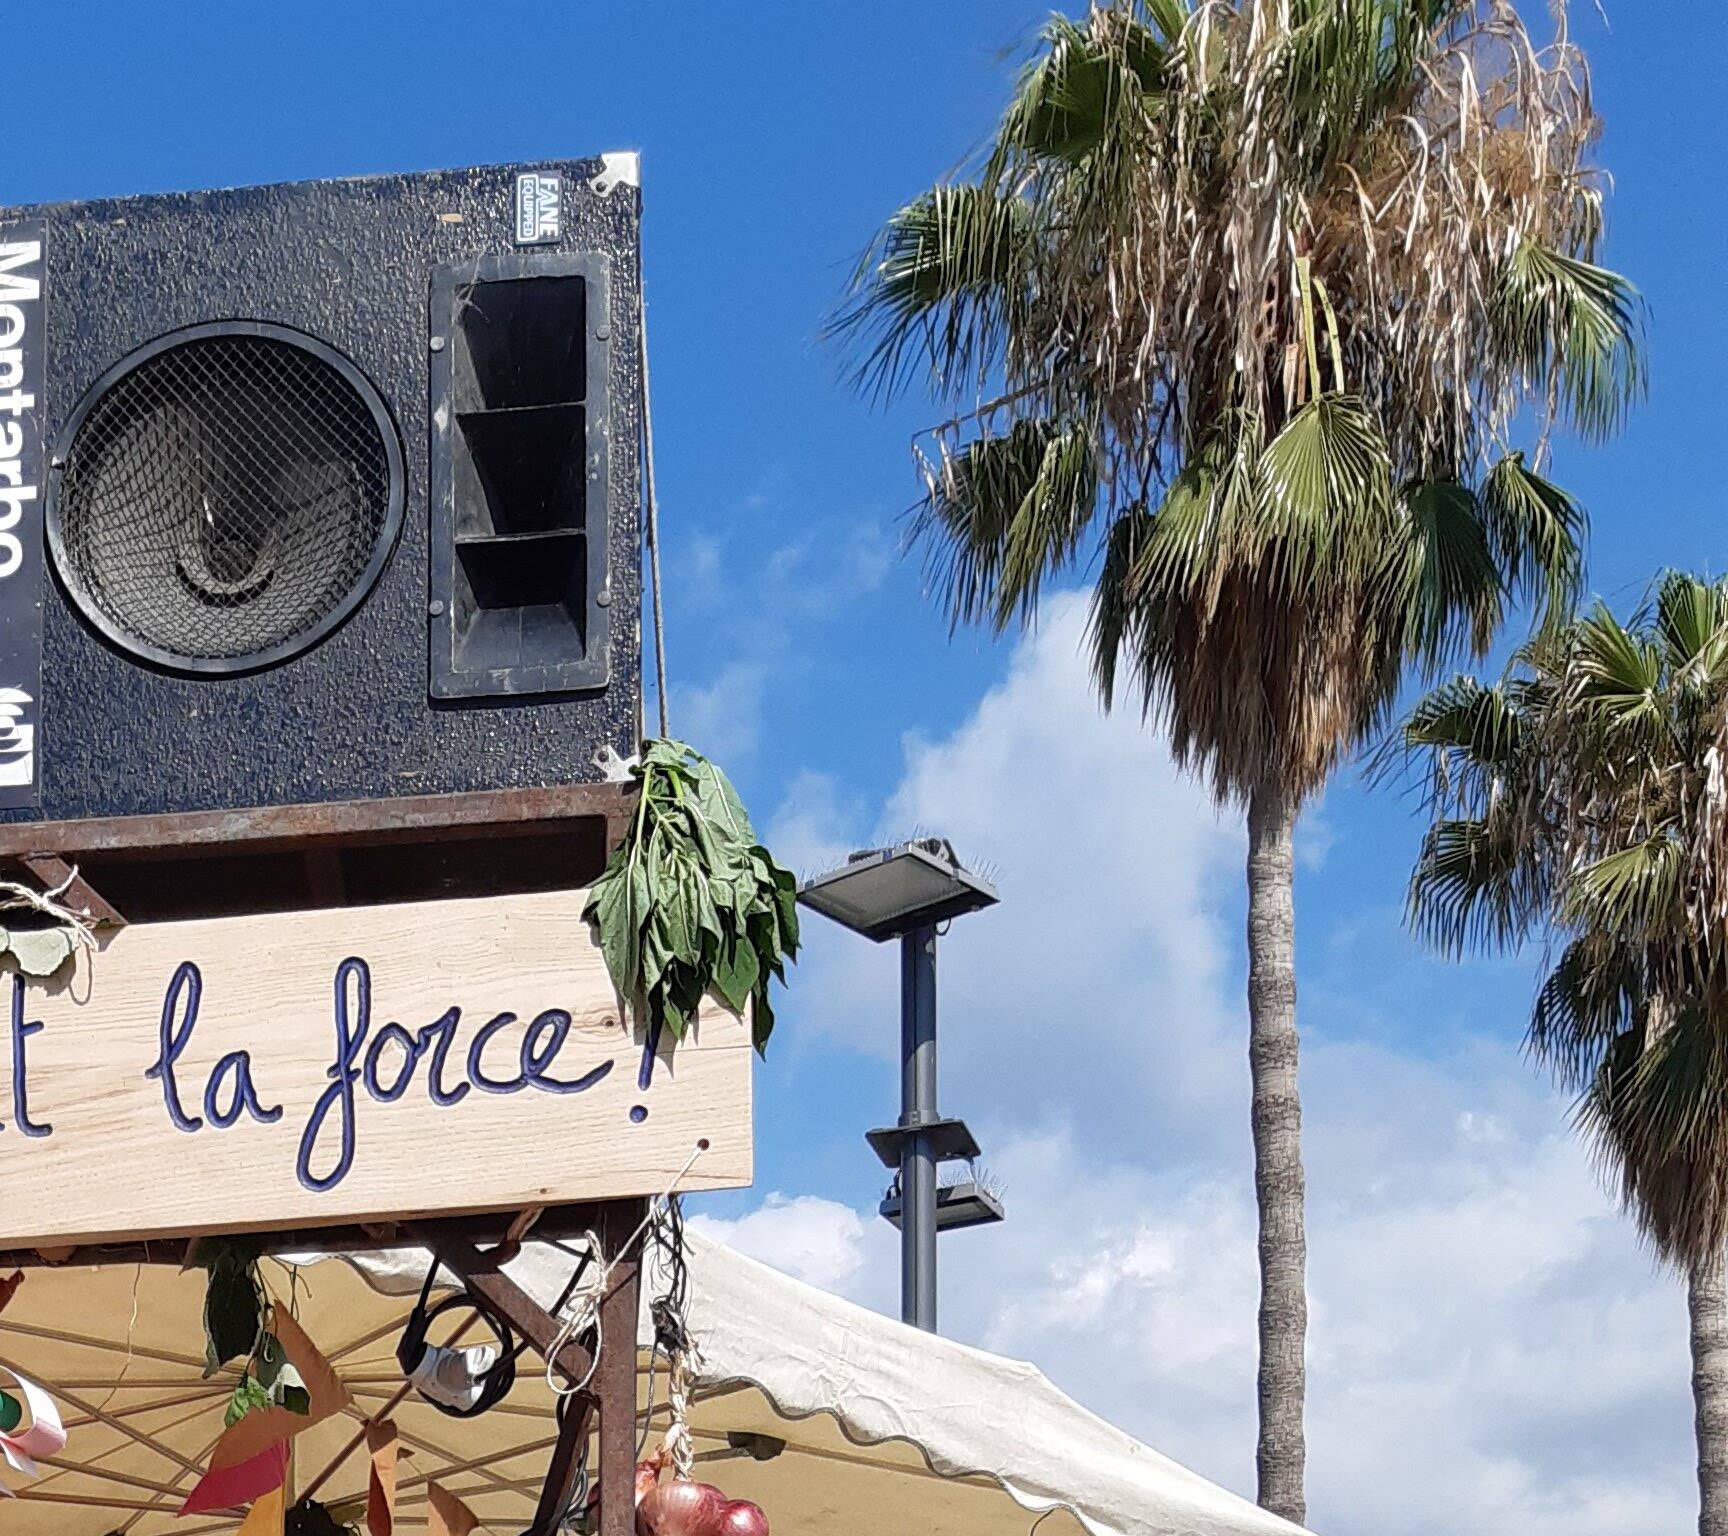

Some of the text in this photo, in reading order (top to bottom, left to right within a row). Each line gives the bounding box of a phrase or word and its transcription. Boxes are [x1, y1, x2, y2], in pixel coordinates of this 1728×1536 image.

[522, 179, 534, 237] EQUIPPED
[539, 178, 559, 237] FANE
[145, 960, 283, 1133] la
